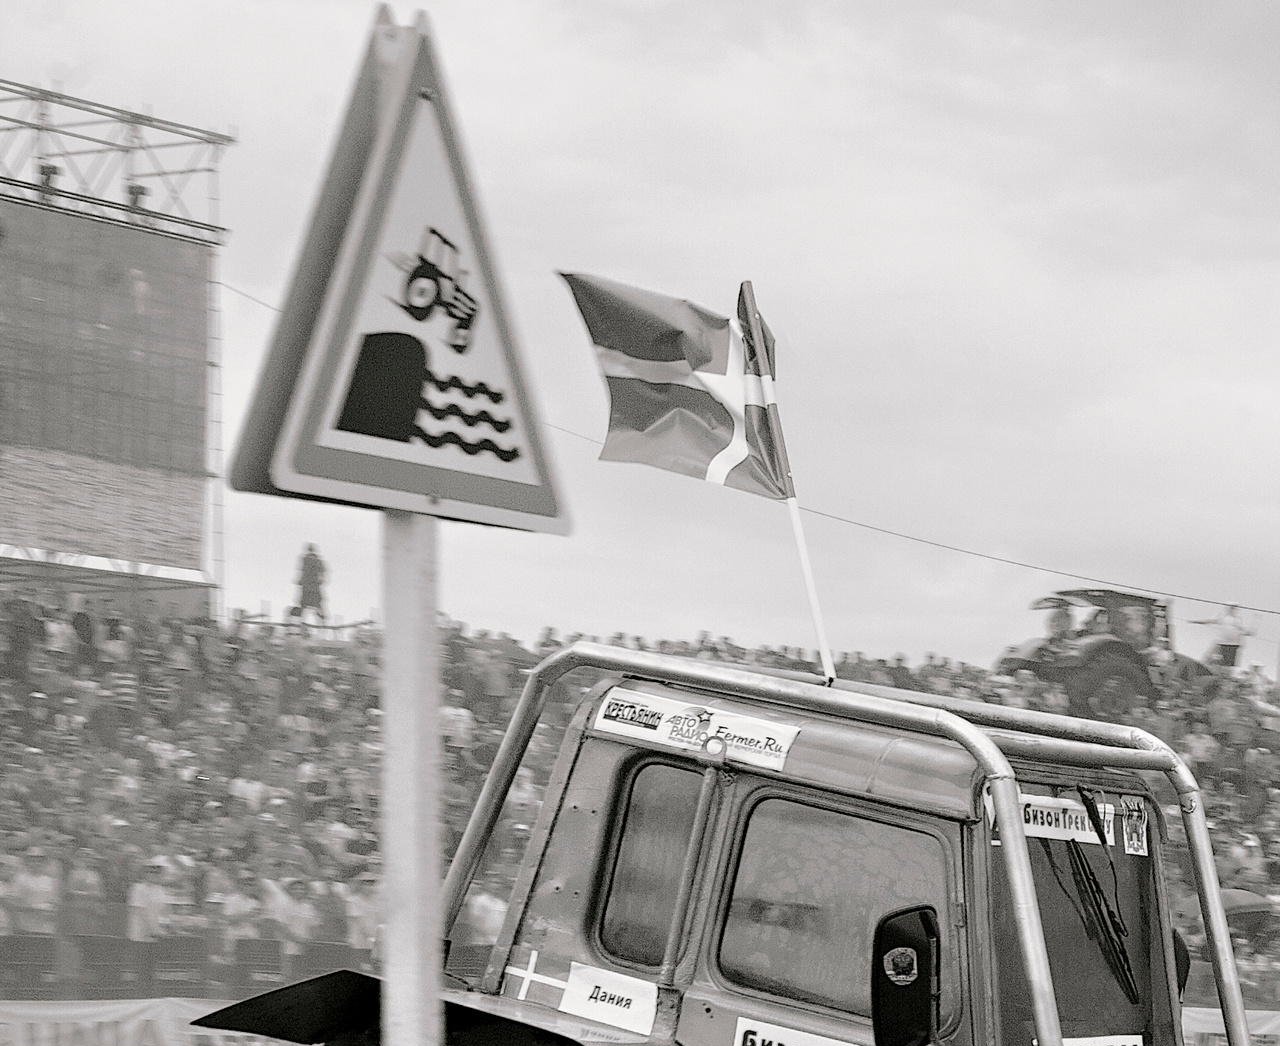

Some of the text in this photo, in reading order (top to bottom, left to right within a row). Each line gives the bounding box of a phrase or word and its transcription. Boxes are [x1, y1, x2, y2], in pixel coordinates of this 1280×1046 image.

[604, 701, 664, 728] КРЕСТЬЯНИН
[665, 715, 697, 728] АВТО
[670, 725, 708, 741] РАДИО
[715, 726, 783, 753] Fermer.Ru
[588, 985, 632, 1009] Дания
